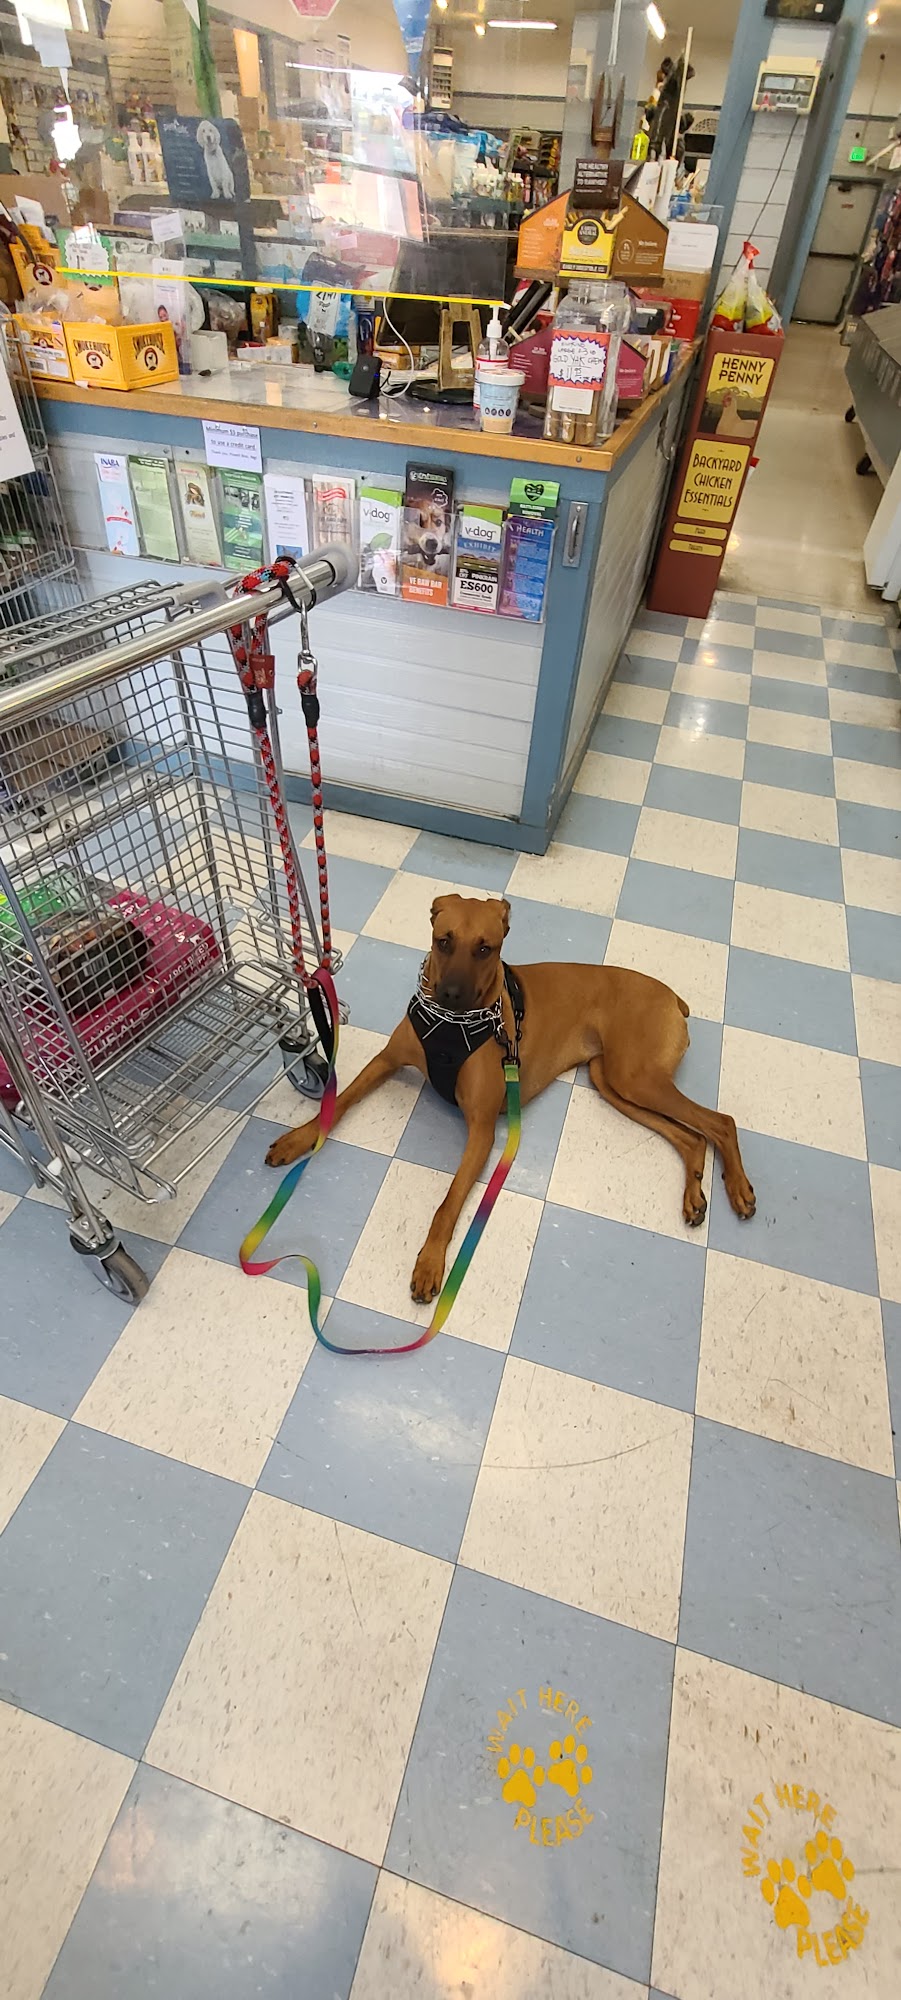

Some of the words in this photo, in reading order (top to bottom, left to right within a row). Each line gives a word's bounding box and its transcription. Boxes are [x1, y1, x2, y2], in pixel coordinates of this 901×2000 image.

[73, 339, 113, 361] SMOKEHOUSE
[132, 333, 165, 360] SMOKEHOUSE
[722, 357, 767, 373] HENNY
[719, 370, 763, 385] PENNY
[693, 453, 742, 472] BACKYARD
[694, 472, 733, 490] CHICKEN
[684, 489, 733, 508] ESSENTIALS
[363, 507, 390, 523] v-dog
[465, 526, 493, 541] v-dog
[516, 524, 545, 537] HEALTH
[460, 580, 494, 594] ES600
[486, 1688, 527, 1754] WAIT
[538, 1685, 593, 1738] HERE
[512, 1798, 594, 1847] PLEASE
[739, 1792, 771, 1878] WAIT
[774, 1783, 838, 1832] HERE
[796, 1895, 870, 1968] PLEASE
